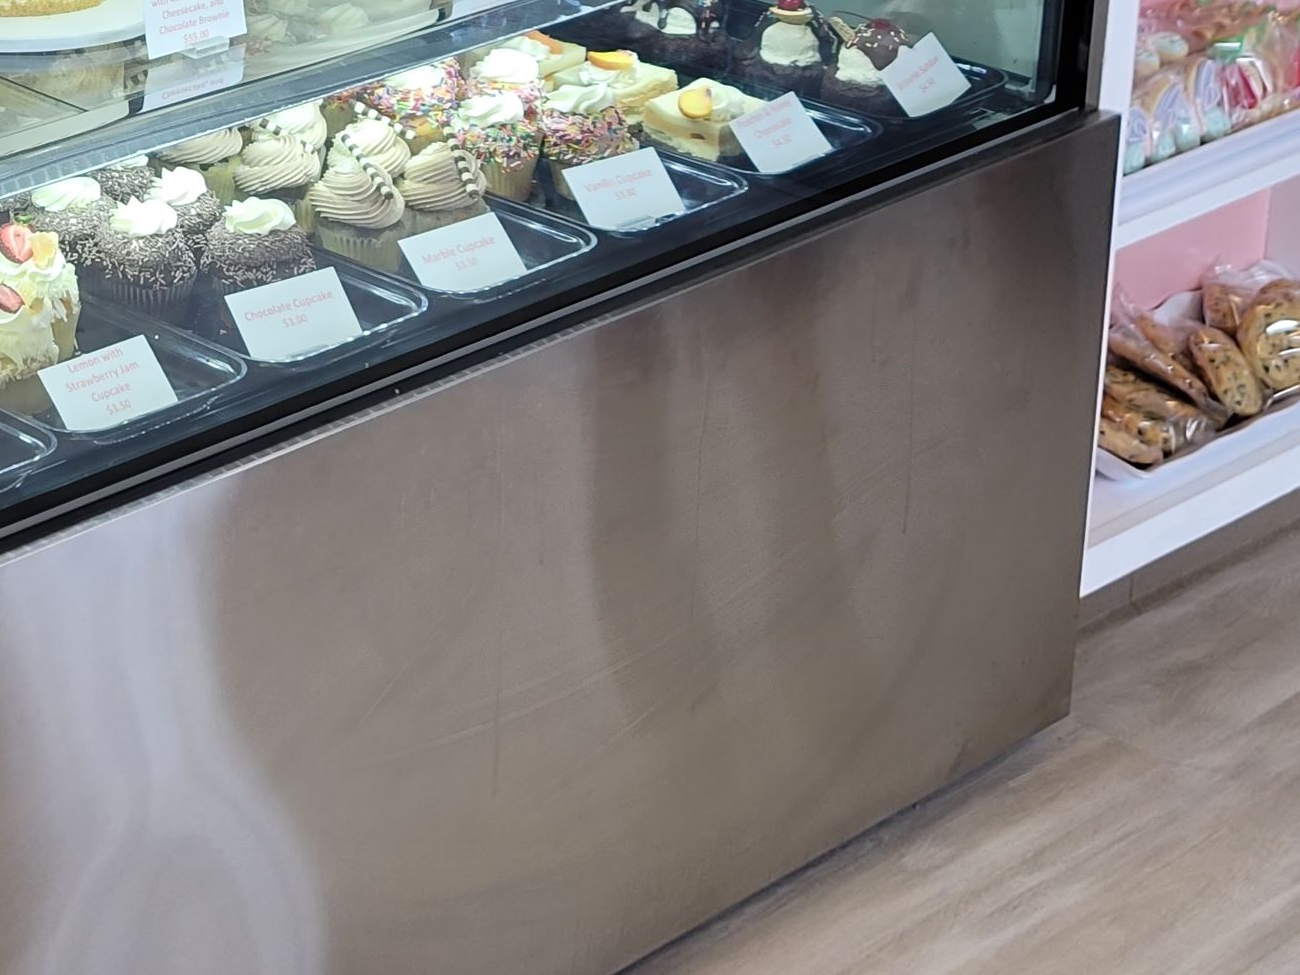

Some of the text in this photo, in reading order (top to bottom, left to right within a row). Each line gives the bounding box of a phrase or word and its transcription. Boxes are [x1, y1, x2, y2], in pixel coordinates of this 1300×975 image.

[159, 10, 230, 35] Chocolate Brownie
[162, 2, 208, 19] Cheesecake,
[423, 235, 495, 264] Marble Cupcake
[244, 290, 333, 321] Chocolate Cupcake
[67, 347, 124, 374] Lemon with
[65, 360, 140, 393] Strawberry Jam
[91, 383, 131, 402] Cupcake
[106, 399, 132, 415] $3.50
